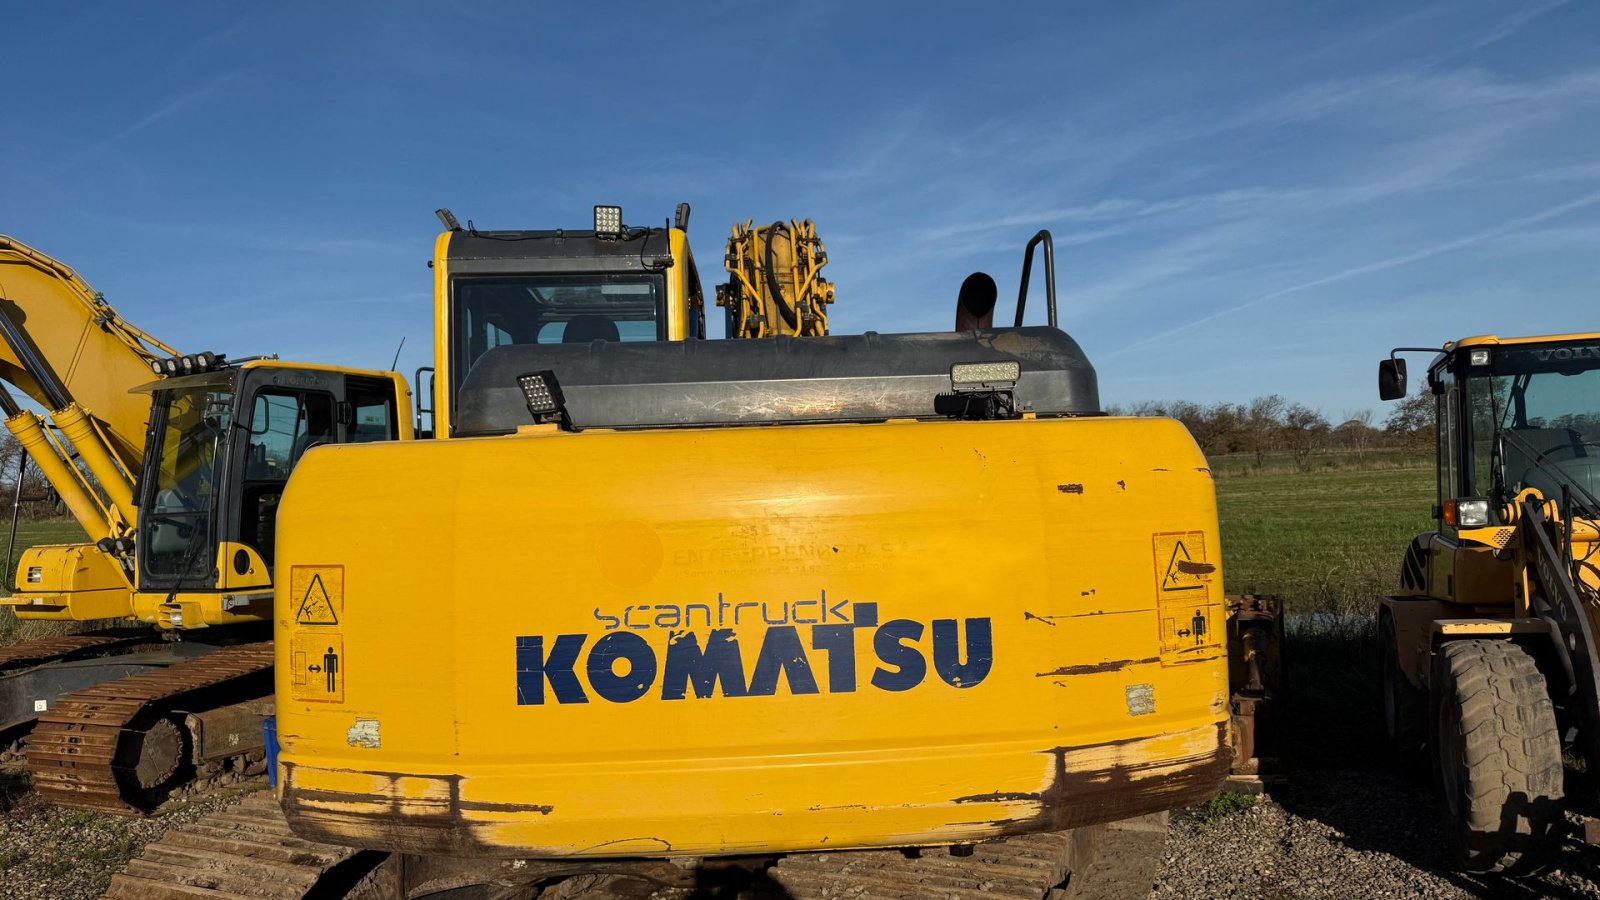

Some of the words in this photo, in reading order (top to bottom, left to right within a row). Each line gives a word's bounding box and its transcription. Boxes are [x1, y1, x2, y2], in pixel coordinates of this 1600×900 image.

[593, 589, 851, 630] scantruck
[1536, 542, 1567, 622] VOLVO
[516, 602, 991, 705] KOMATSU
